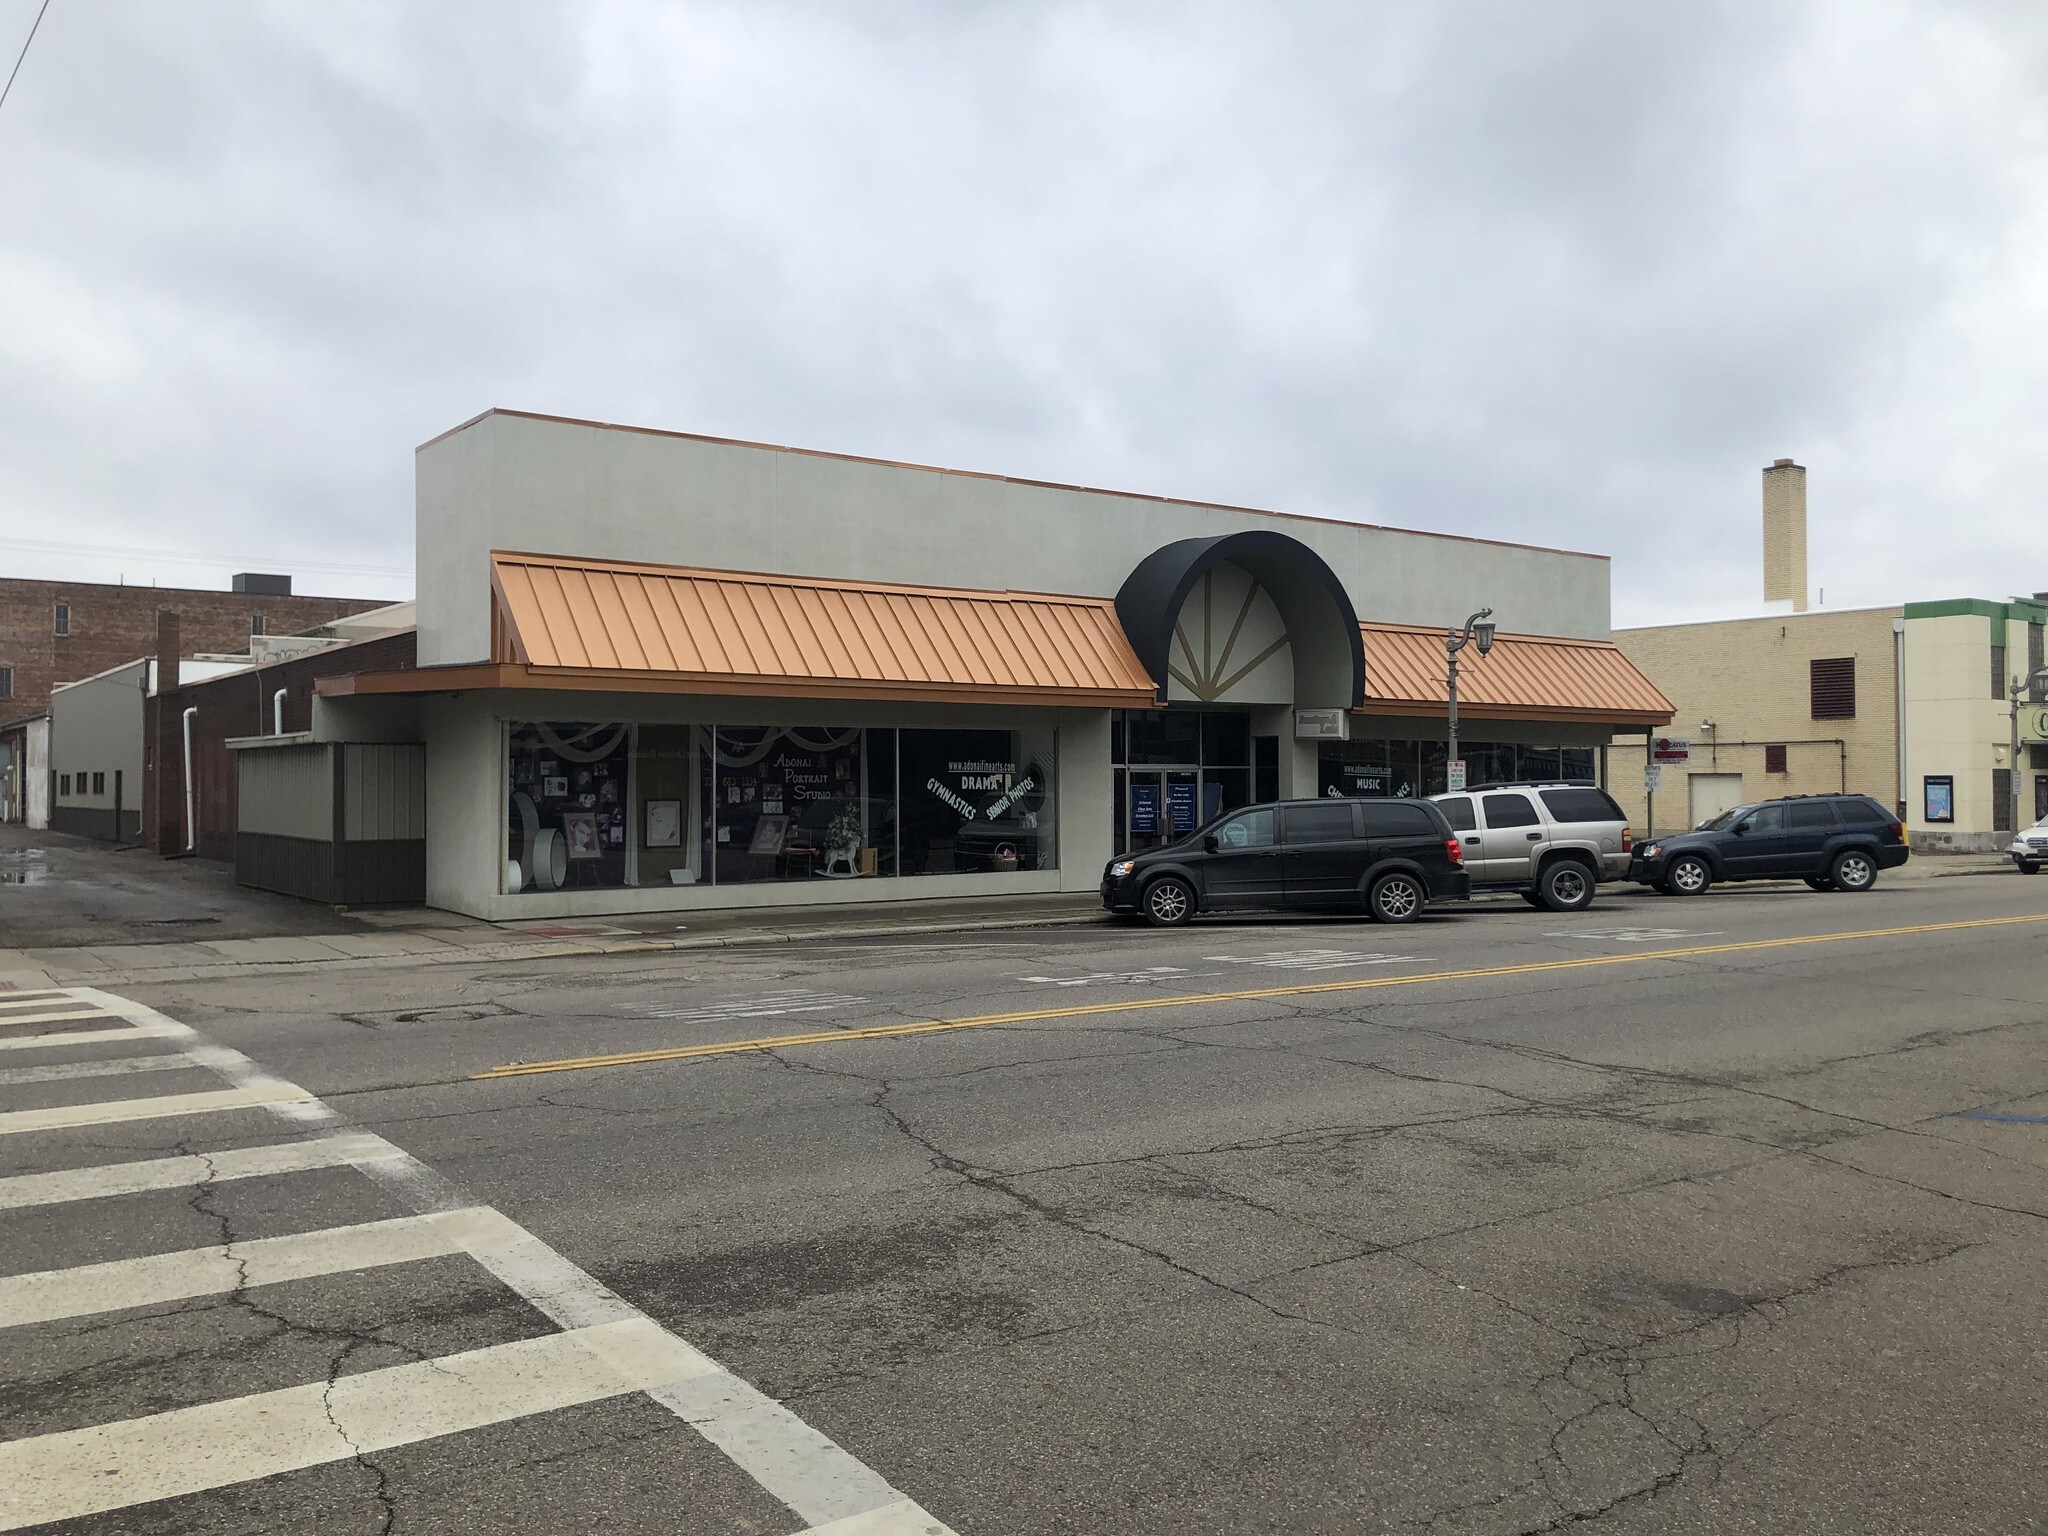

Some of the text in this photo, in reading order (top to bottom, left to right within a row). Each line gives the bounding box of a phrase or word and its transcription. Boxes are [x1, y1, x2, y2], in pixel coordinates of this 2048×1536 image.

[773, 753, 812, 768] ADONAI
[948, 760, 1016, 772] www.adonaifinearts.com
[784, 769, 828, 784] PORTRAIT
[962, 776, 998, 790] DRAMA
[1357, 778, 1380, 790] MUSIC
[794, 785, 831, 800] STUDIO
[927, 777, 977, 820] GYMNASTICS
[986, 776, 1035, 821] SENIOR PHOTOS
